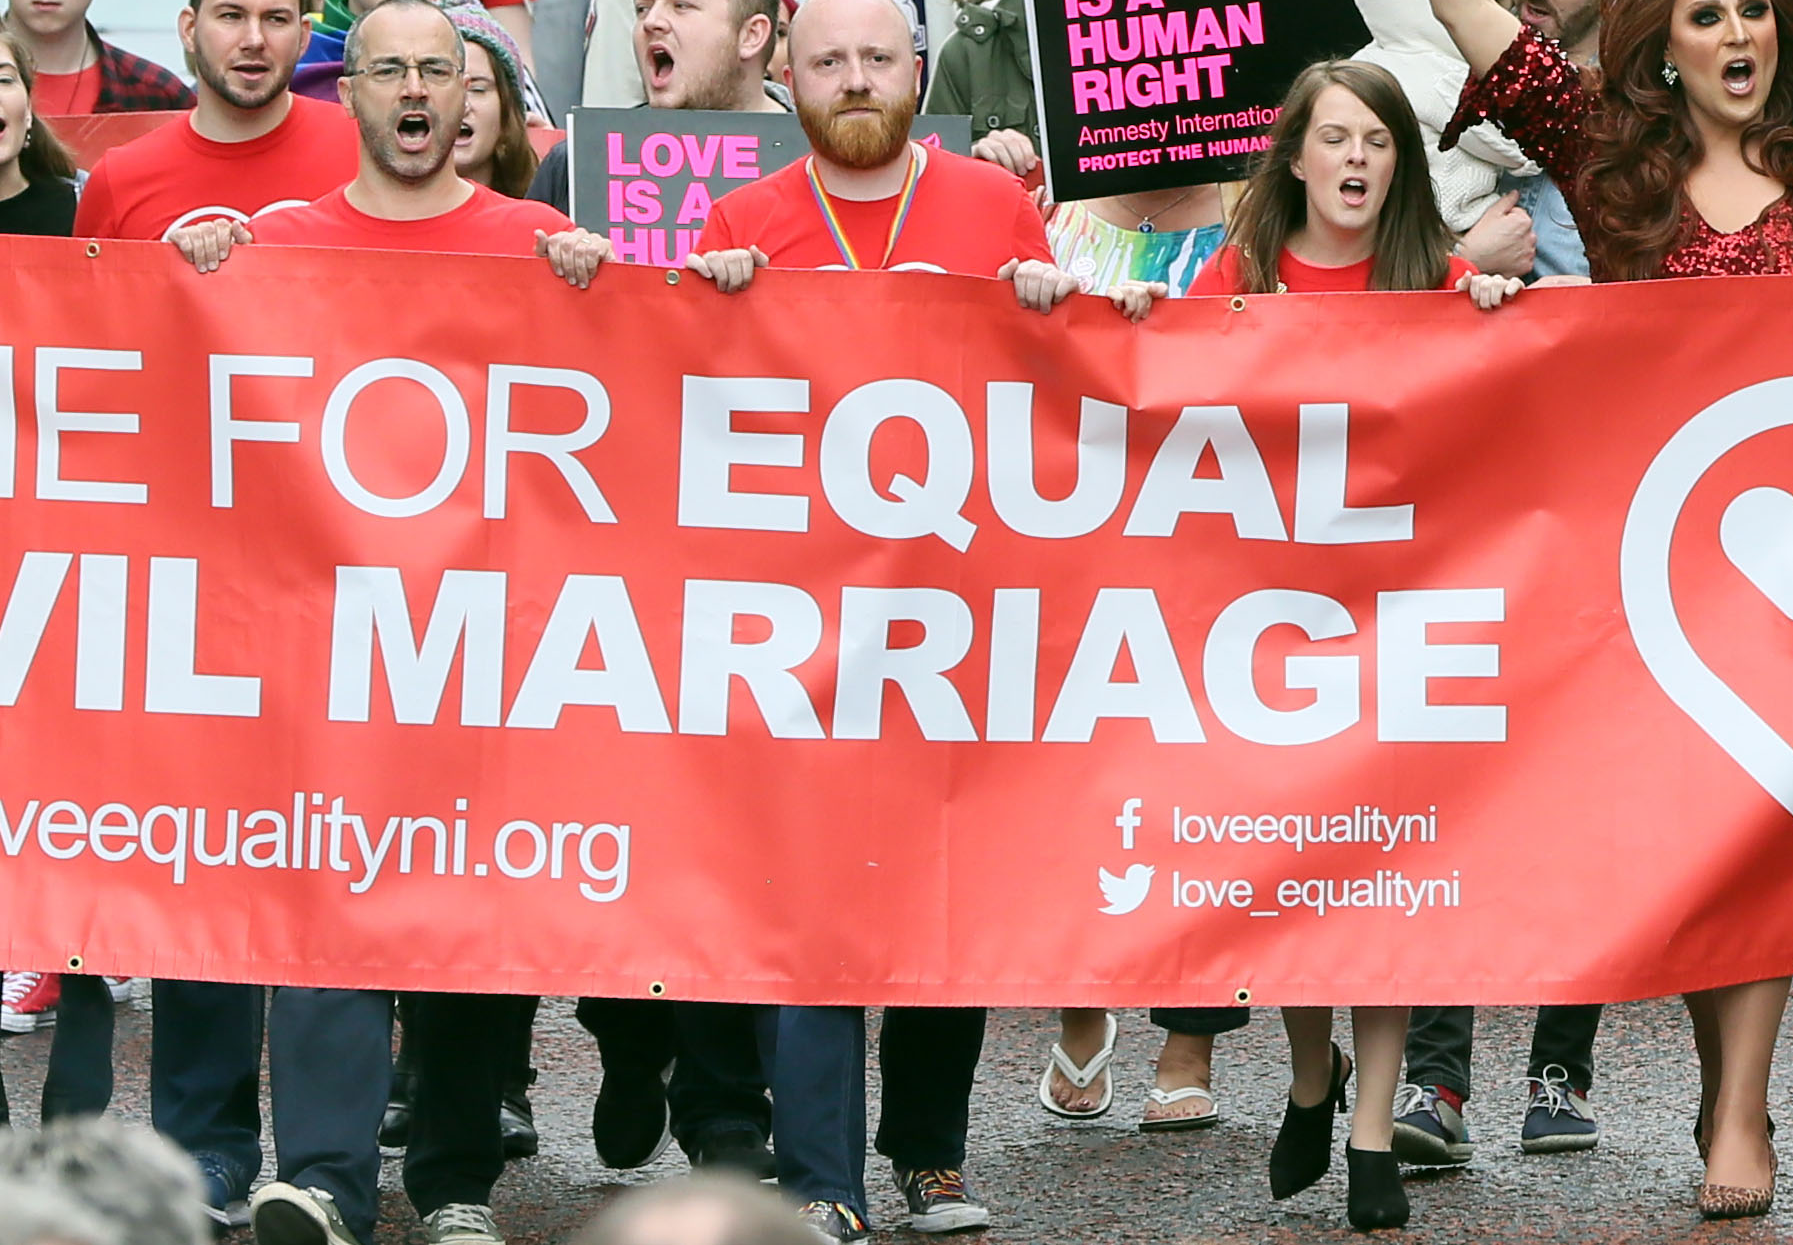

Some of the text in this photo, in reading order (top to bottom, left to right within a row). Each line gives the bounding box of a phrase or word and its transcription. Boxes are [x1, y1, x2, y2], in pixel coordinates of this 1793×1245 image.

[1067, 1, 1265, 67] HUMAN
[1072, 53, 1232, 115] RIGHT
[1078, 106, 1284, 148] Amnesty Internatio
[606, 132, 761, 179] LOVE
[1079, 135, 1275, 173] PROTECT THE HUMAN
[606, 180, 713, 225] IS A
[207, 353, 619, 525] FOR
[677, 374, 1416, 555] EQUAL
[327, 565, 1508, 746] MARRIAGE
[1172, 805, 1438, 848] loveequalityni
[1171, 870, 1462, 918] love_equalityni
